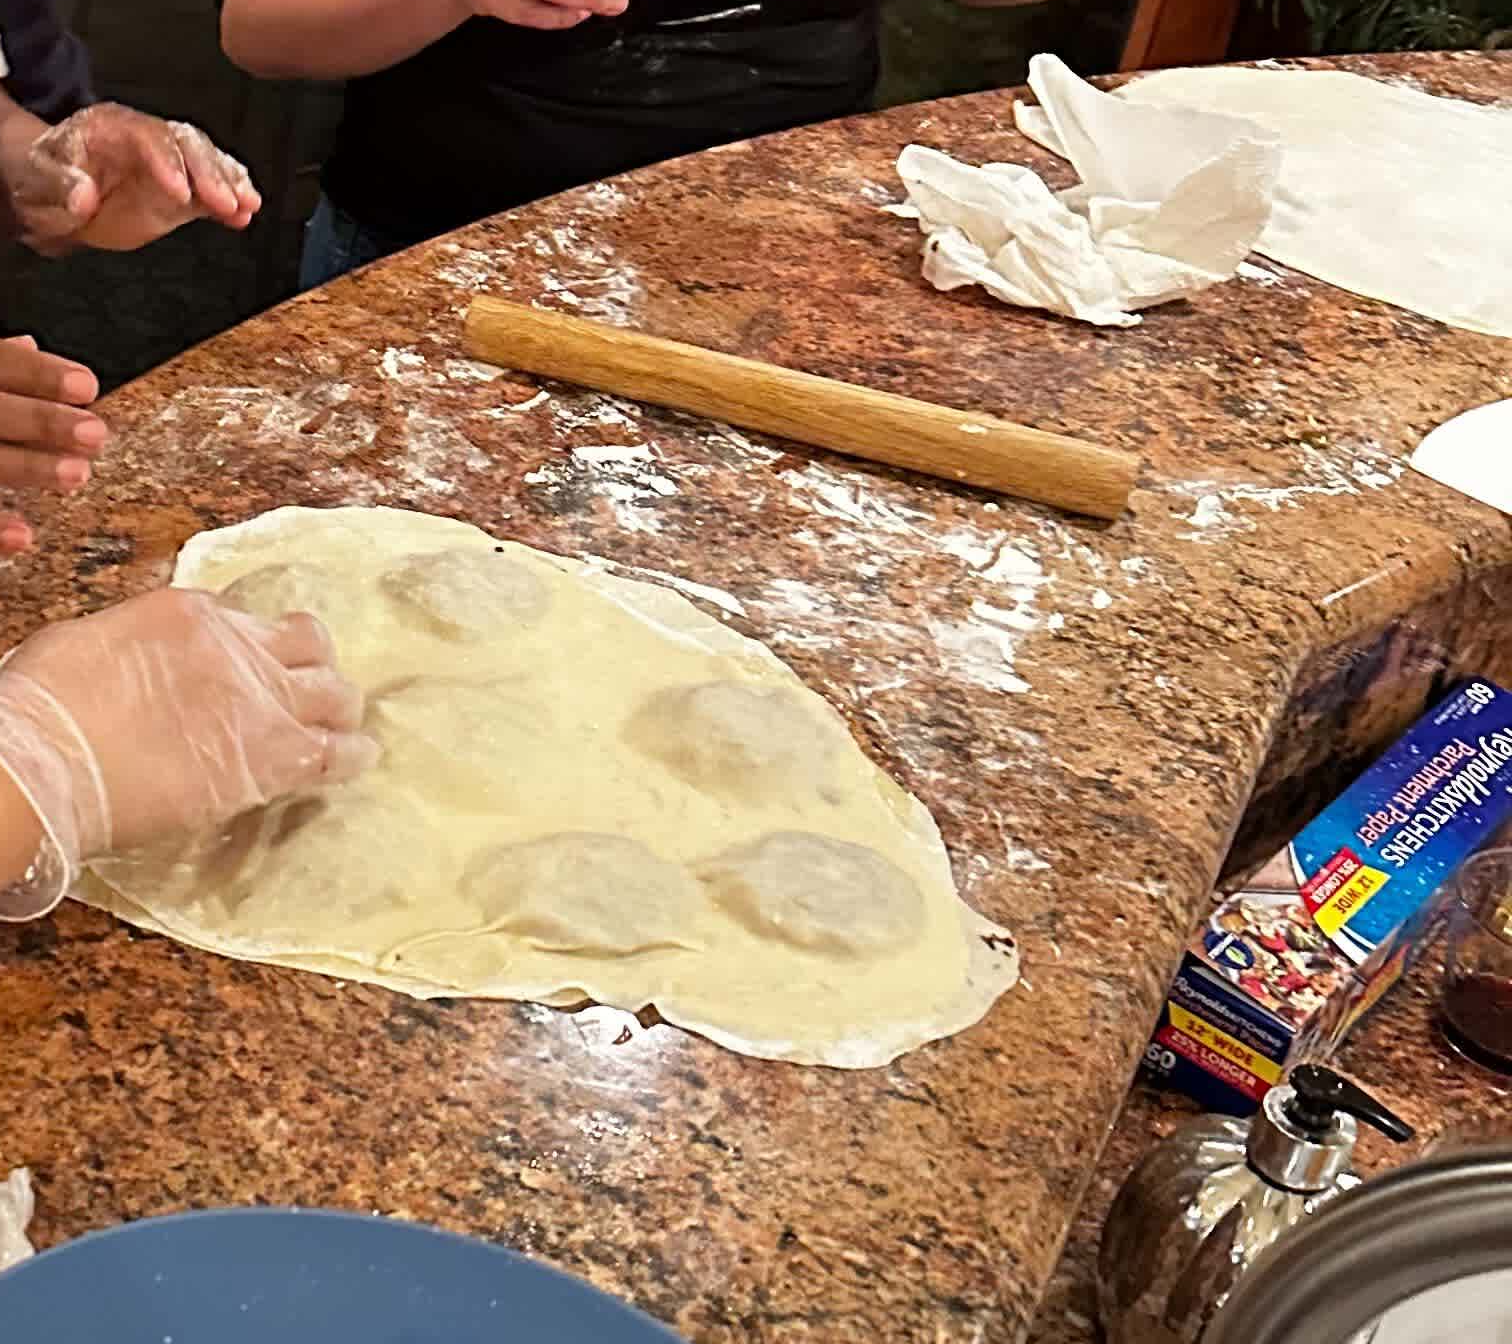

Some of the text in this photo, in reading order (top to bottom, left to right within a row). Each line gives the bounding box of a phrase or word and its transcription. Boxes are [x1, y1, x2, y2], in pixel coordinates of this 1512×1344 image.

[1465, 682, 1495, 704] 60
[1355, 738, 1477, 848] Parchment Paper
